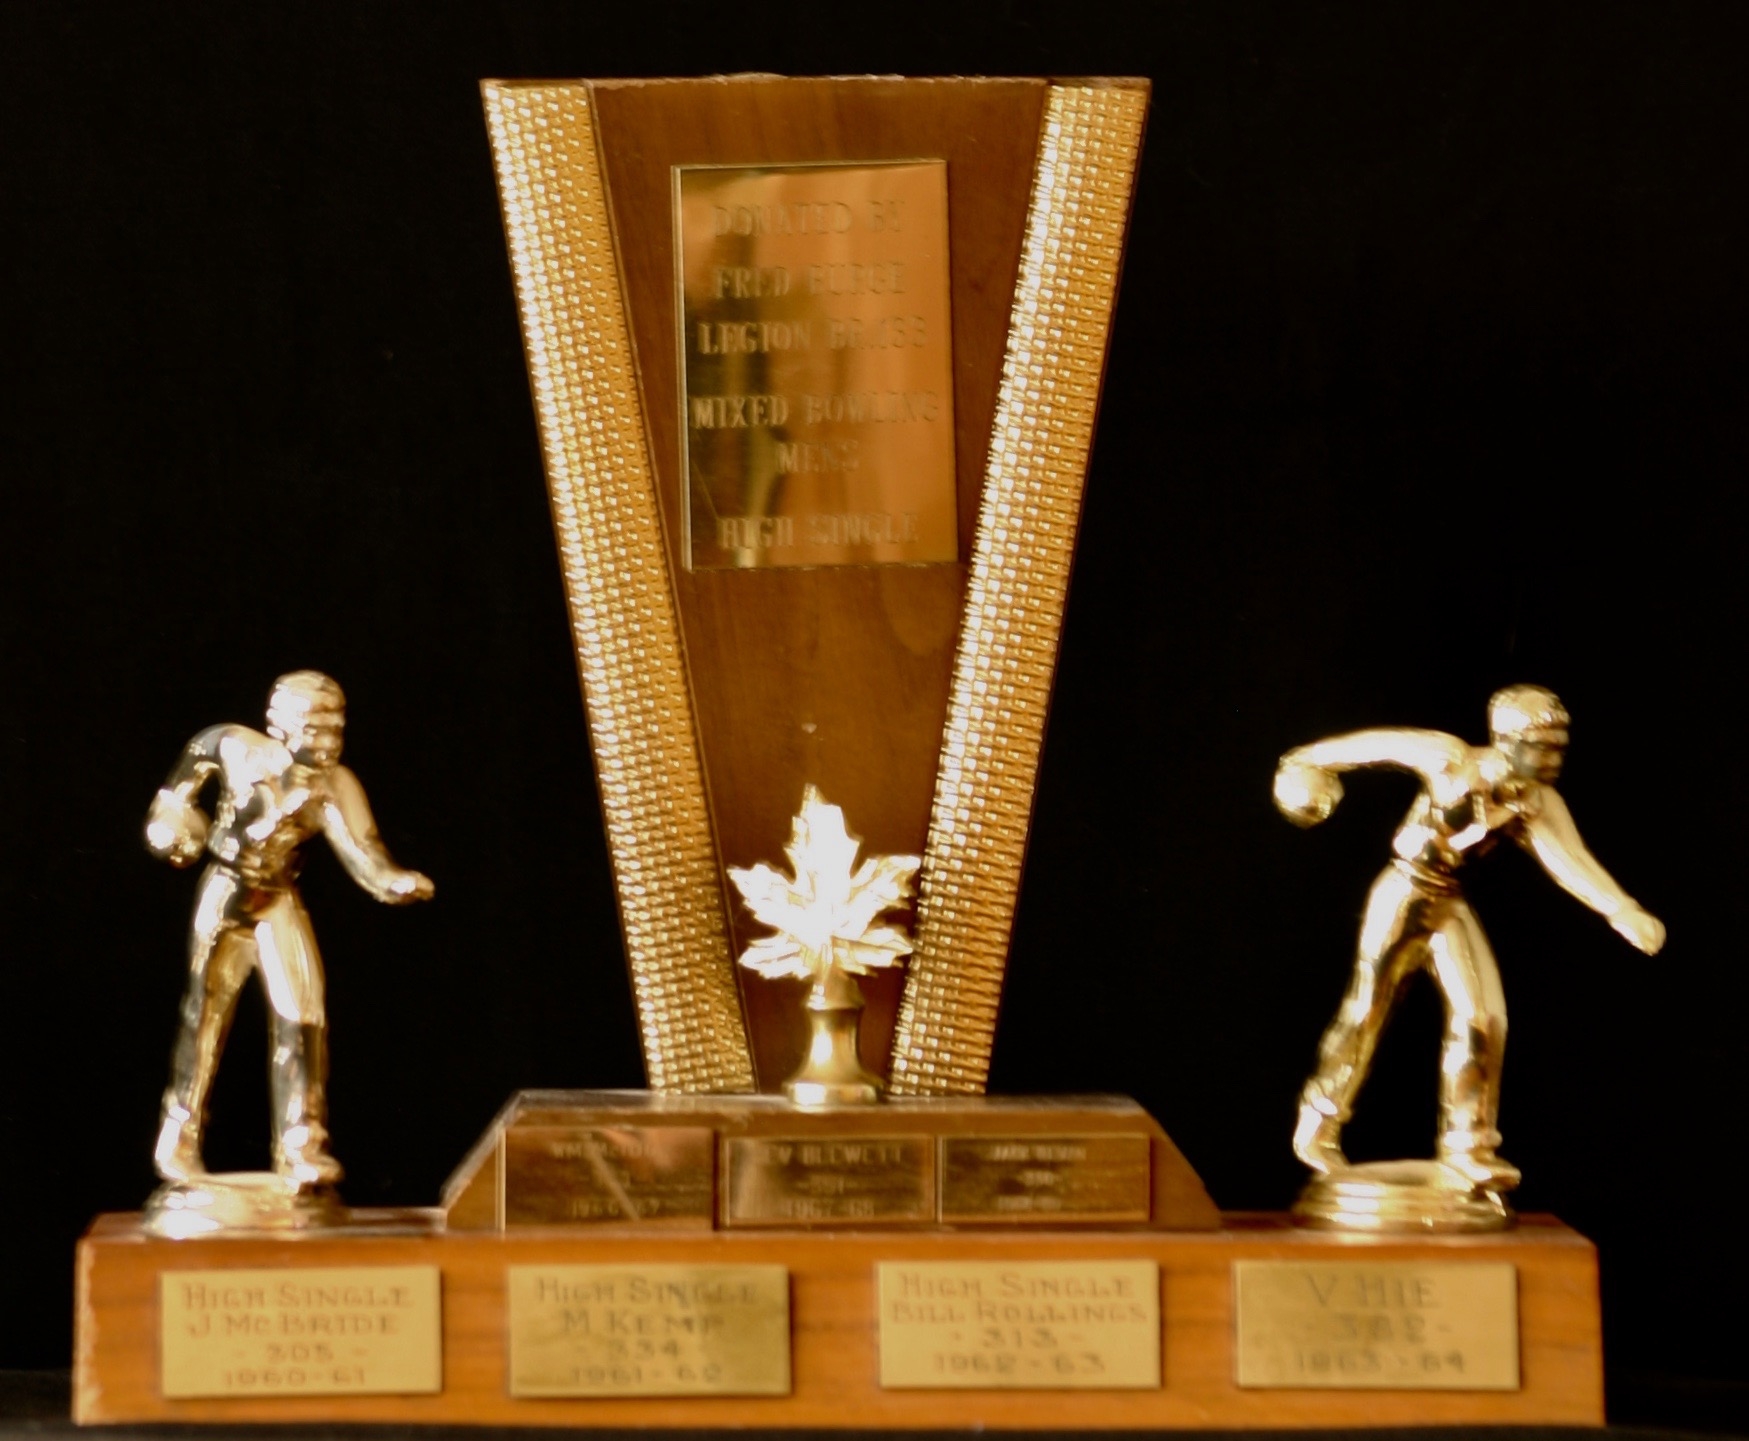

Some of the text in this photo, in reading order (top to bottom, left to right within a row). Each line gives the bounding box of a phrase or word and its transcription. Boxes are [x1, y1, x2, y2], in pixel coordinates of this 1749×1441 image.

[712, 202, 850, 236] DONATED
[715, 266, 791, 298] FRED
[699, 322, 811, 354] LEGION
[690, 391, 940, 428] MIXED BOWLING
[717, 513, 919, 548] HIGH SINGLE
[1305, 1273, 1339, 1308] V
[186, 1314, 211, 1339] J
[891, 1301, 1149, 1324] BILL ROLLINGS
